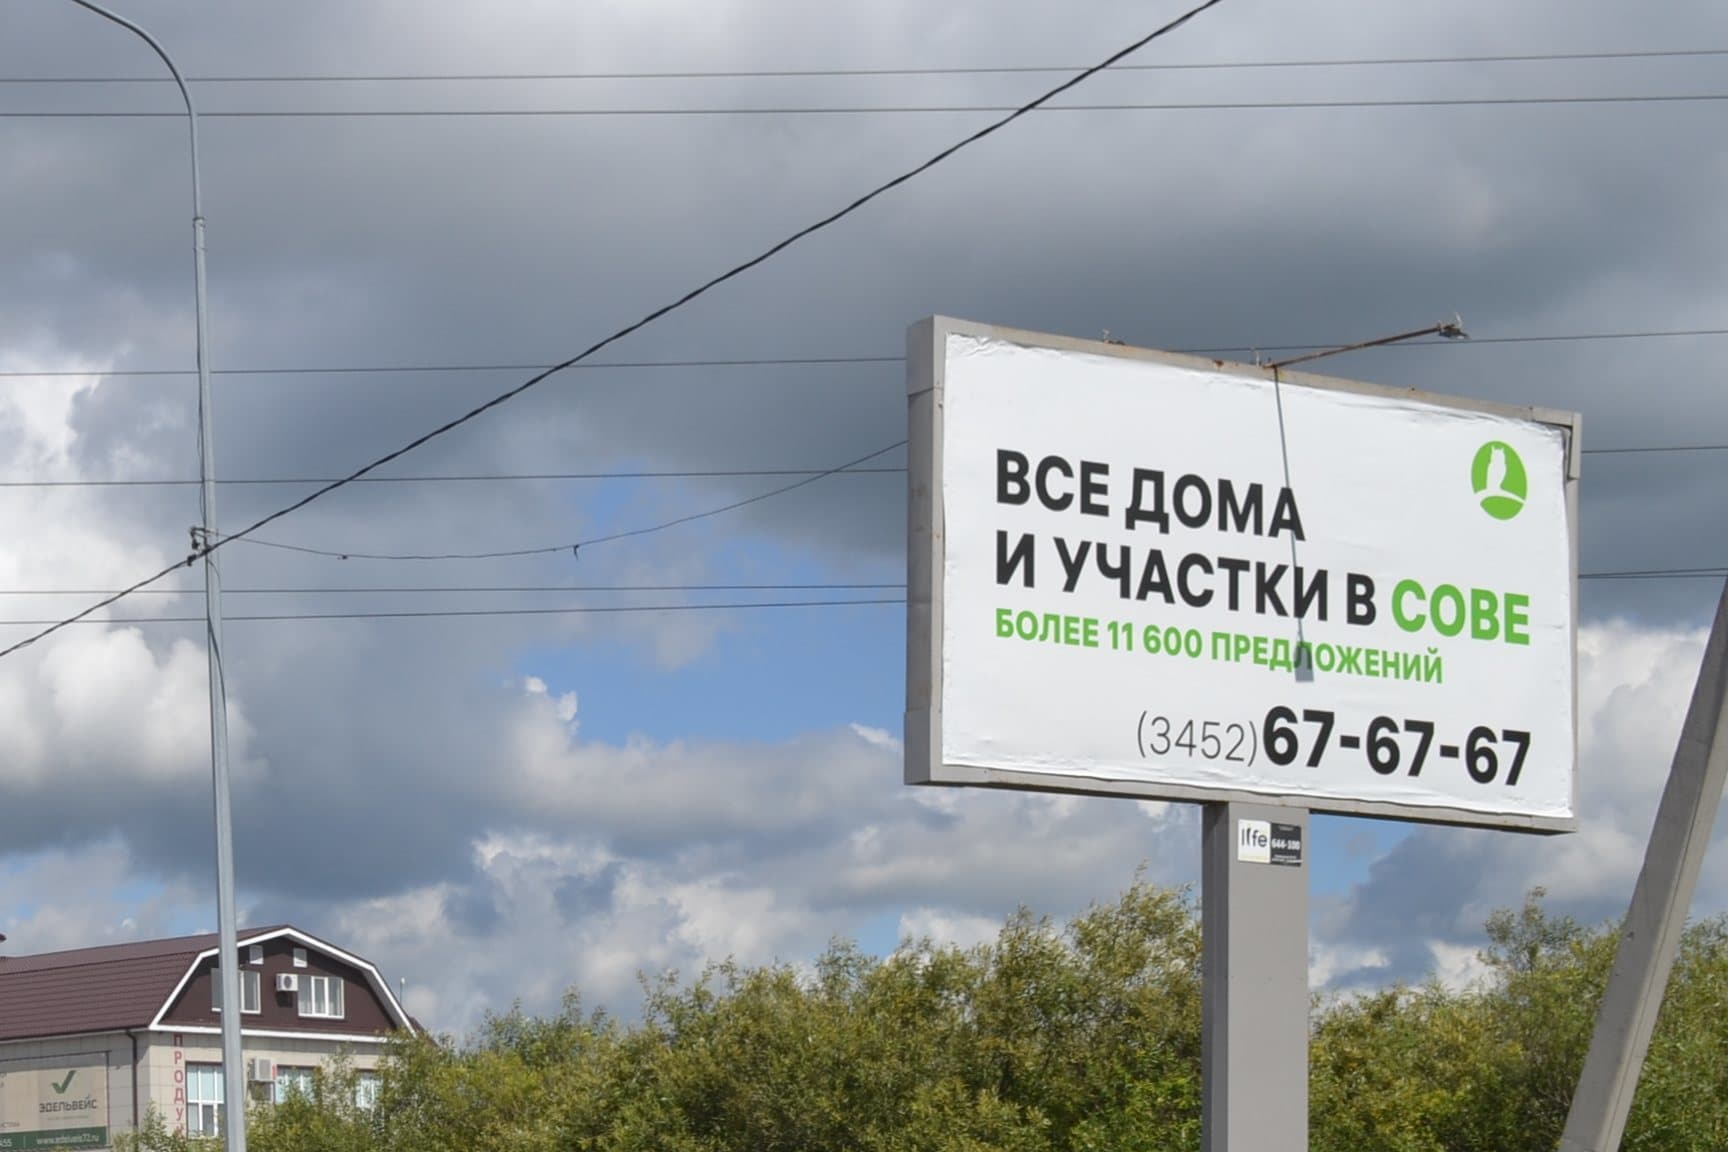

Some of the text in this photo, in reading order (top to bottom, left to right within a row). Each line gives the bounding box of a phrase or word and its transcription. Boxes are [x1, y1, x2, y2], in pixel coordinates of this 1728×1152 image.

[996, 449, 1305, 541] ВСЕ ДОМА
[996, 530, 1531, 646] И УЧАСТКИ В СОВЕ
[996, 608, 1443, 684] БОЛЕЕ 11 600 ПРЕДЛОЖЕНИЙ
[1262, 706, 1532, 786] 67-67-67
[39, 1094, 97, 1113] ЭДЕЛЬВЕЙС
